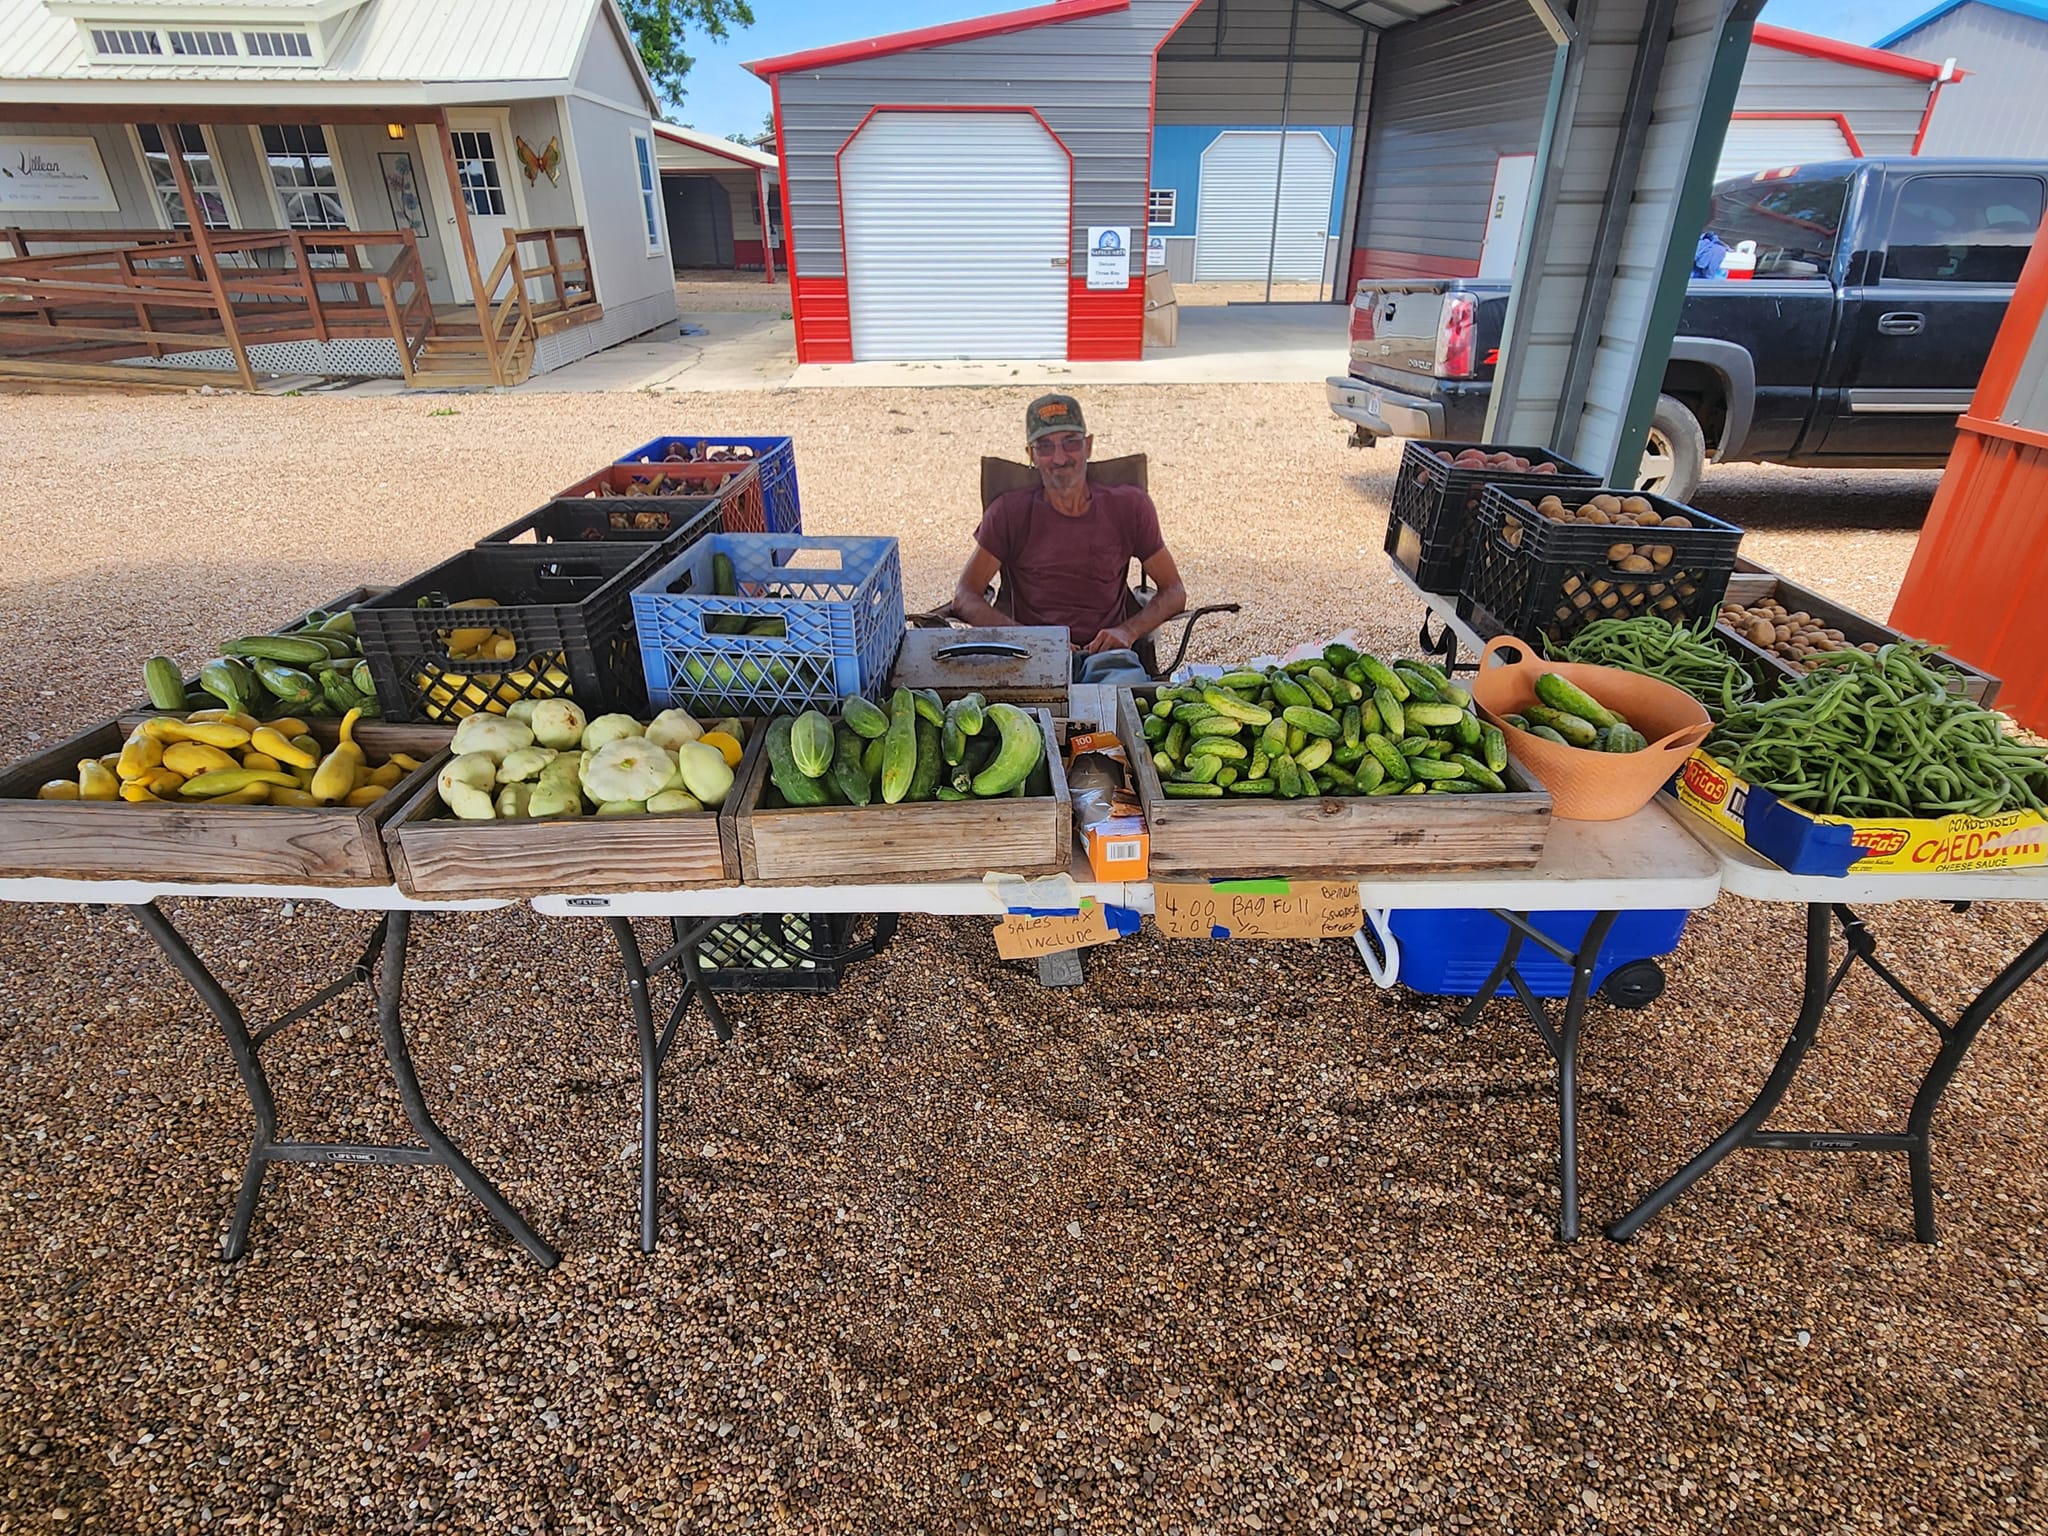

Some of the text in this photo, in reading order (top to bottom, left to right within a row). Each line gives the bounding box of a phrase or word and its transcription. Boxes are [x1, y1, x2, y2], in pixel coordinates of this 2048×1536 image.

[1075, 735, 1092, 746] 100
[1948, 815, 2020, 833] CONDENSED
[1911, 827, 2041, 864] CHEDDAR
[1935, 857, 2008, 873] CHEESE SAUCE
[1165, 891, 1215, 919] 4.00
[333, 1152, 370, 1160] LIFETIME
